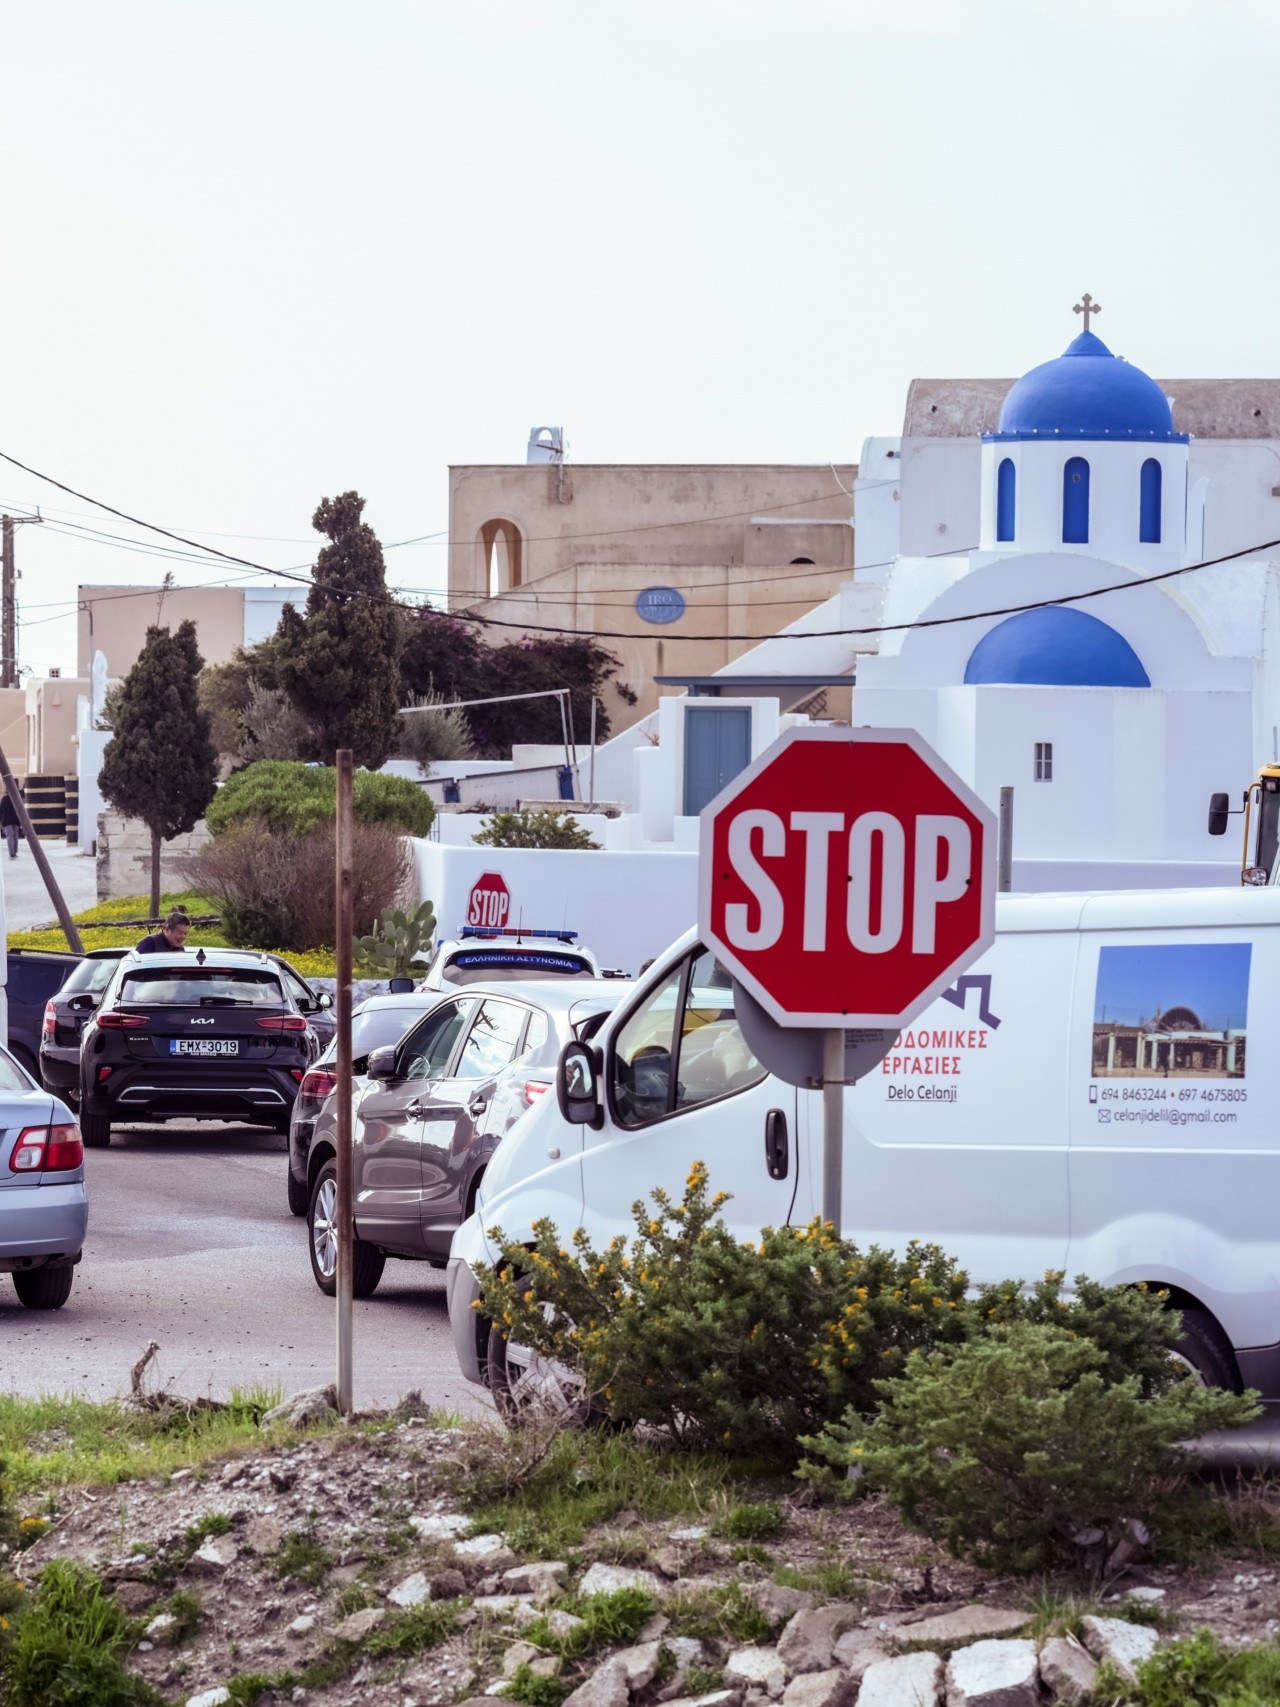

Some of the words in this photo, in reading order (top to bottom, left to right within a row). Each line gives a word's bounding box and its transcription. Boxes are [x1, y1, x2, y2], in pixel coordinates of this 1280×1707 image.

[648, 594, 672, 605] IRO
[725, 808, 972, 954] STOP
[470, 888, 508, 927] STOP
[465, 955, 514, 963] ΕΛΛΗΝΙΚΗ
[516, 956, 573, 968] ΑΣΤΥΝΟΜΙΑ
[882, 1056, 961, 1075] ΕΡΓΑΣΙΕΣ
[888, 1085, 915, 1099] Delo
[917, 1085, 957, 1102] Celanji
[1101, 1088, 1119, 1100] 694
[1122, 1088, 1167, 1101] 8463244
[1178, 1089, 1197, 1102] 697
[1200, 1089, 1248, 1102] 4675805
[1113, 1108, 1238, 1125] celanjidelil@gmail.com
